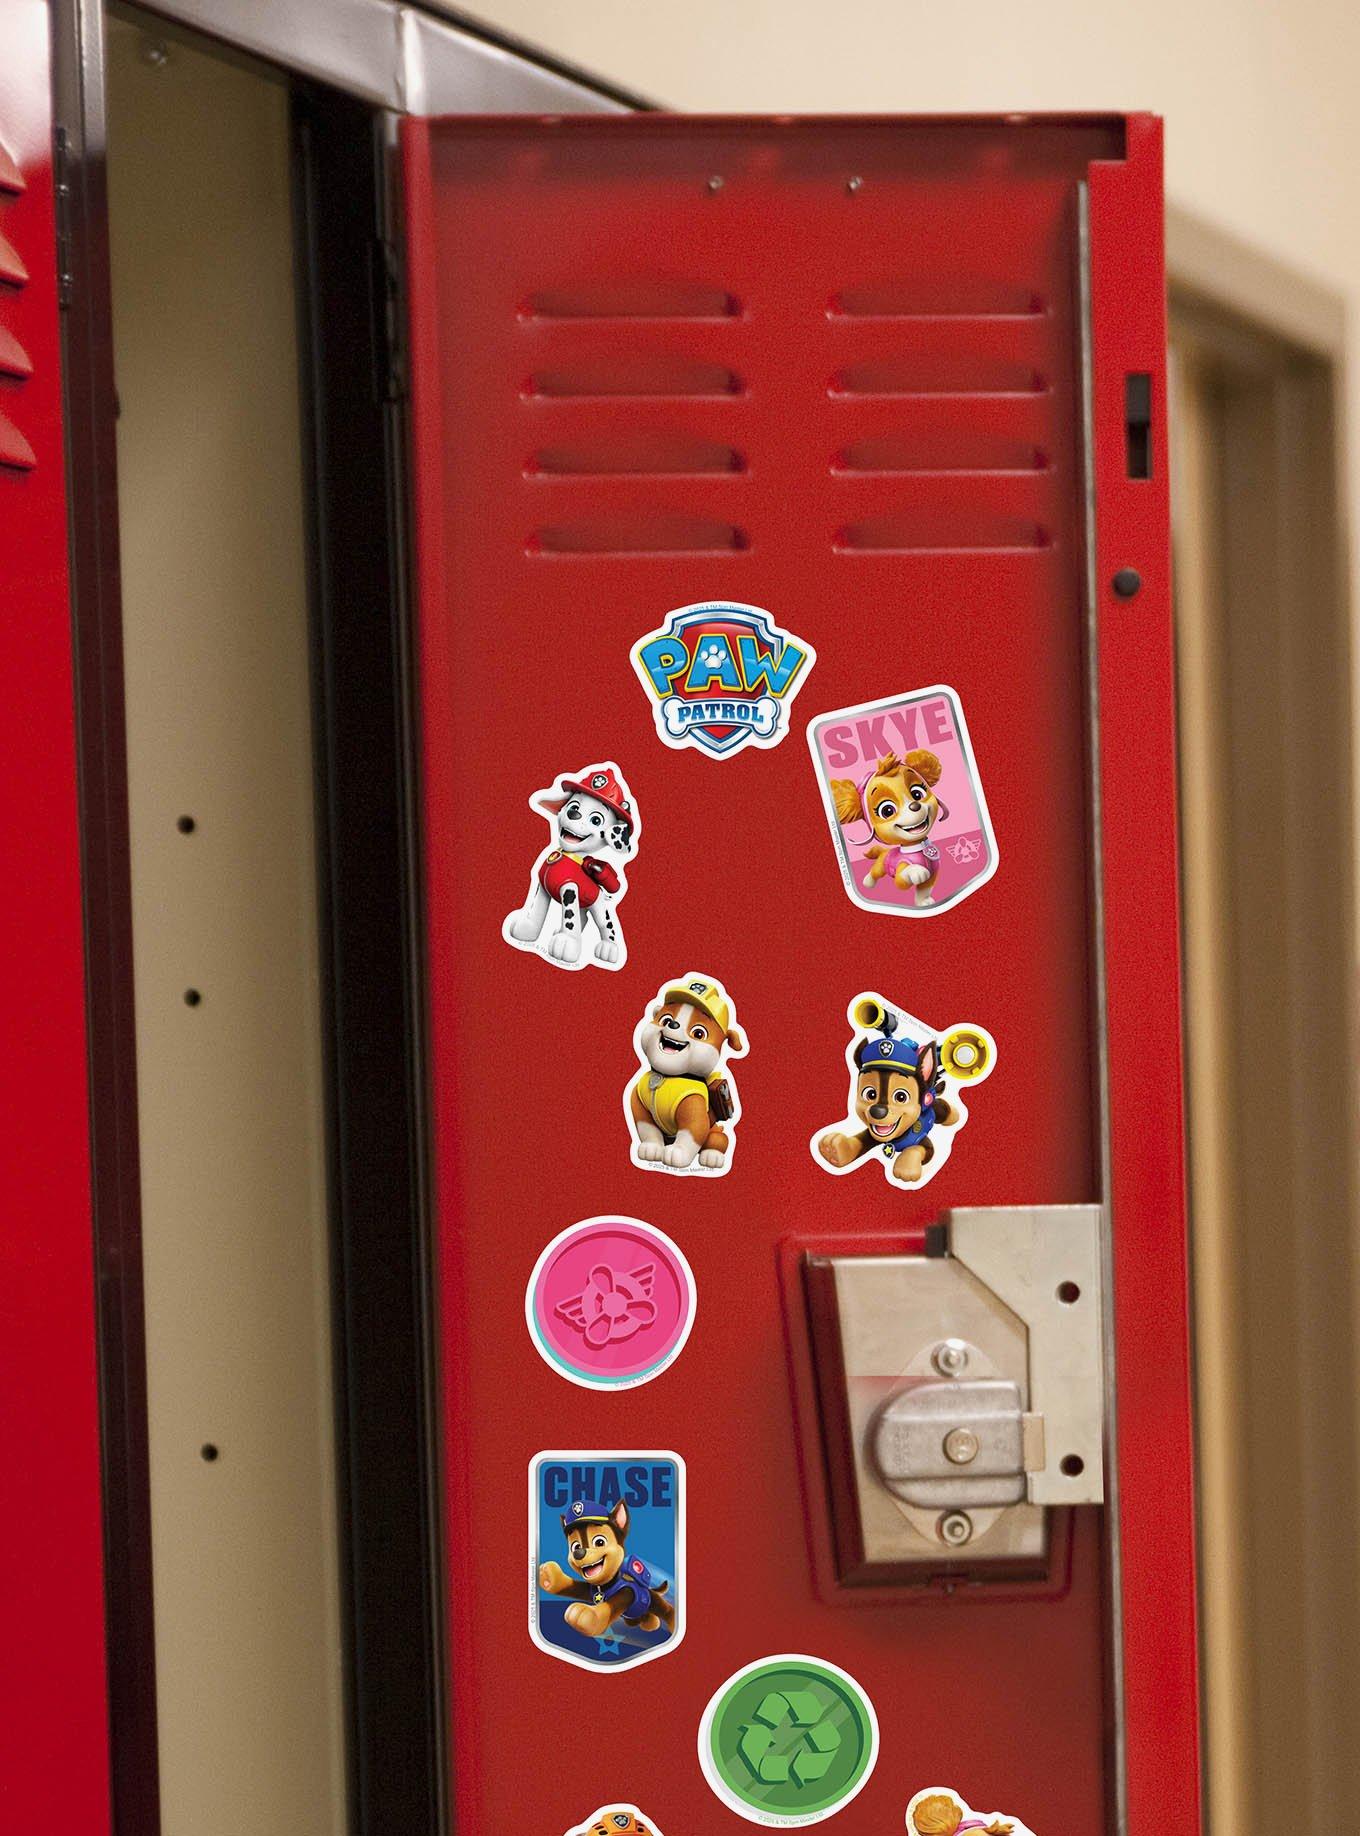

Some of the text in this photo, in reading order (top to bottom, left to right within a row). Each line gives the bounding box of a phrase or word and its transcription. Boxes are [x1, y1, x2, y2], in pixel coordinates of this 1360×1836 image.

[638, 633, 807, 699] PAW
[677, 703, 765, 723] PATROL
[823, 701, 953, 769] SKYE
[544, 1466, 672, 1508] CHASE
